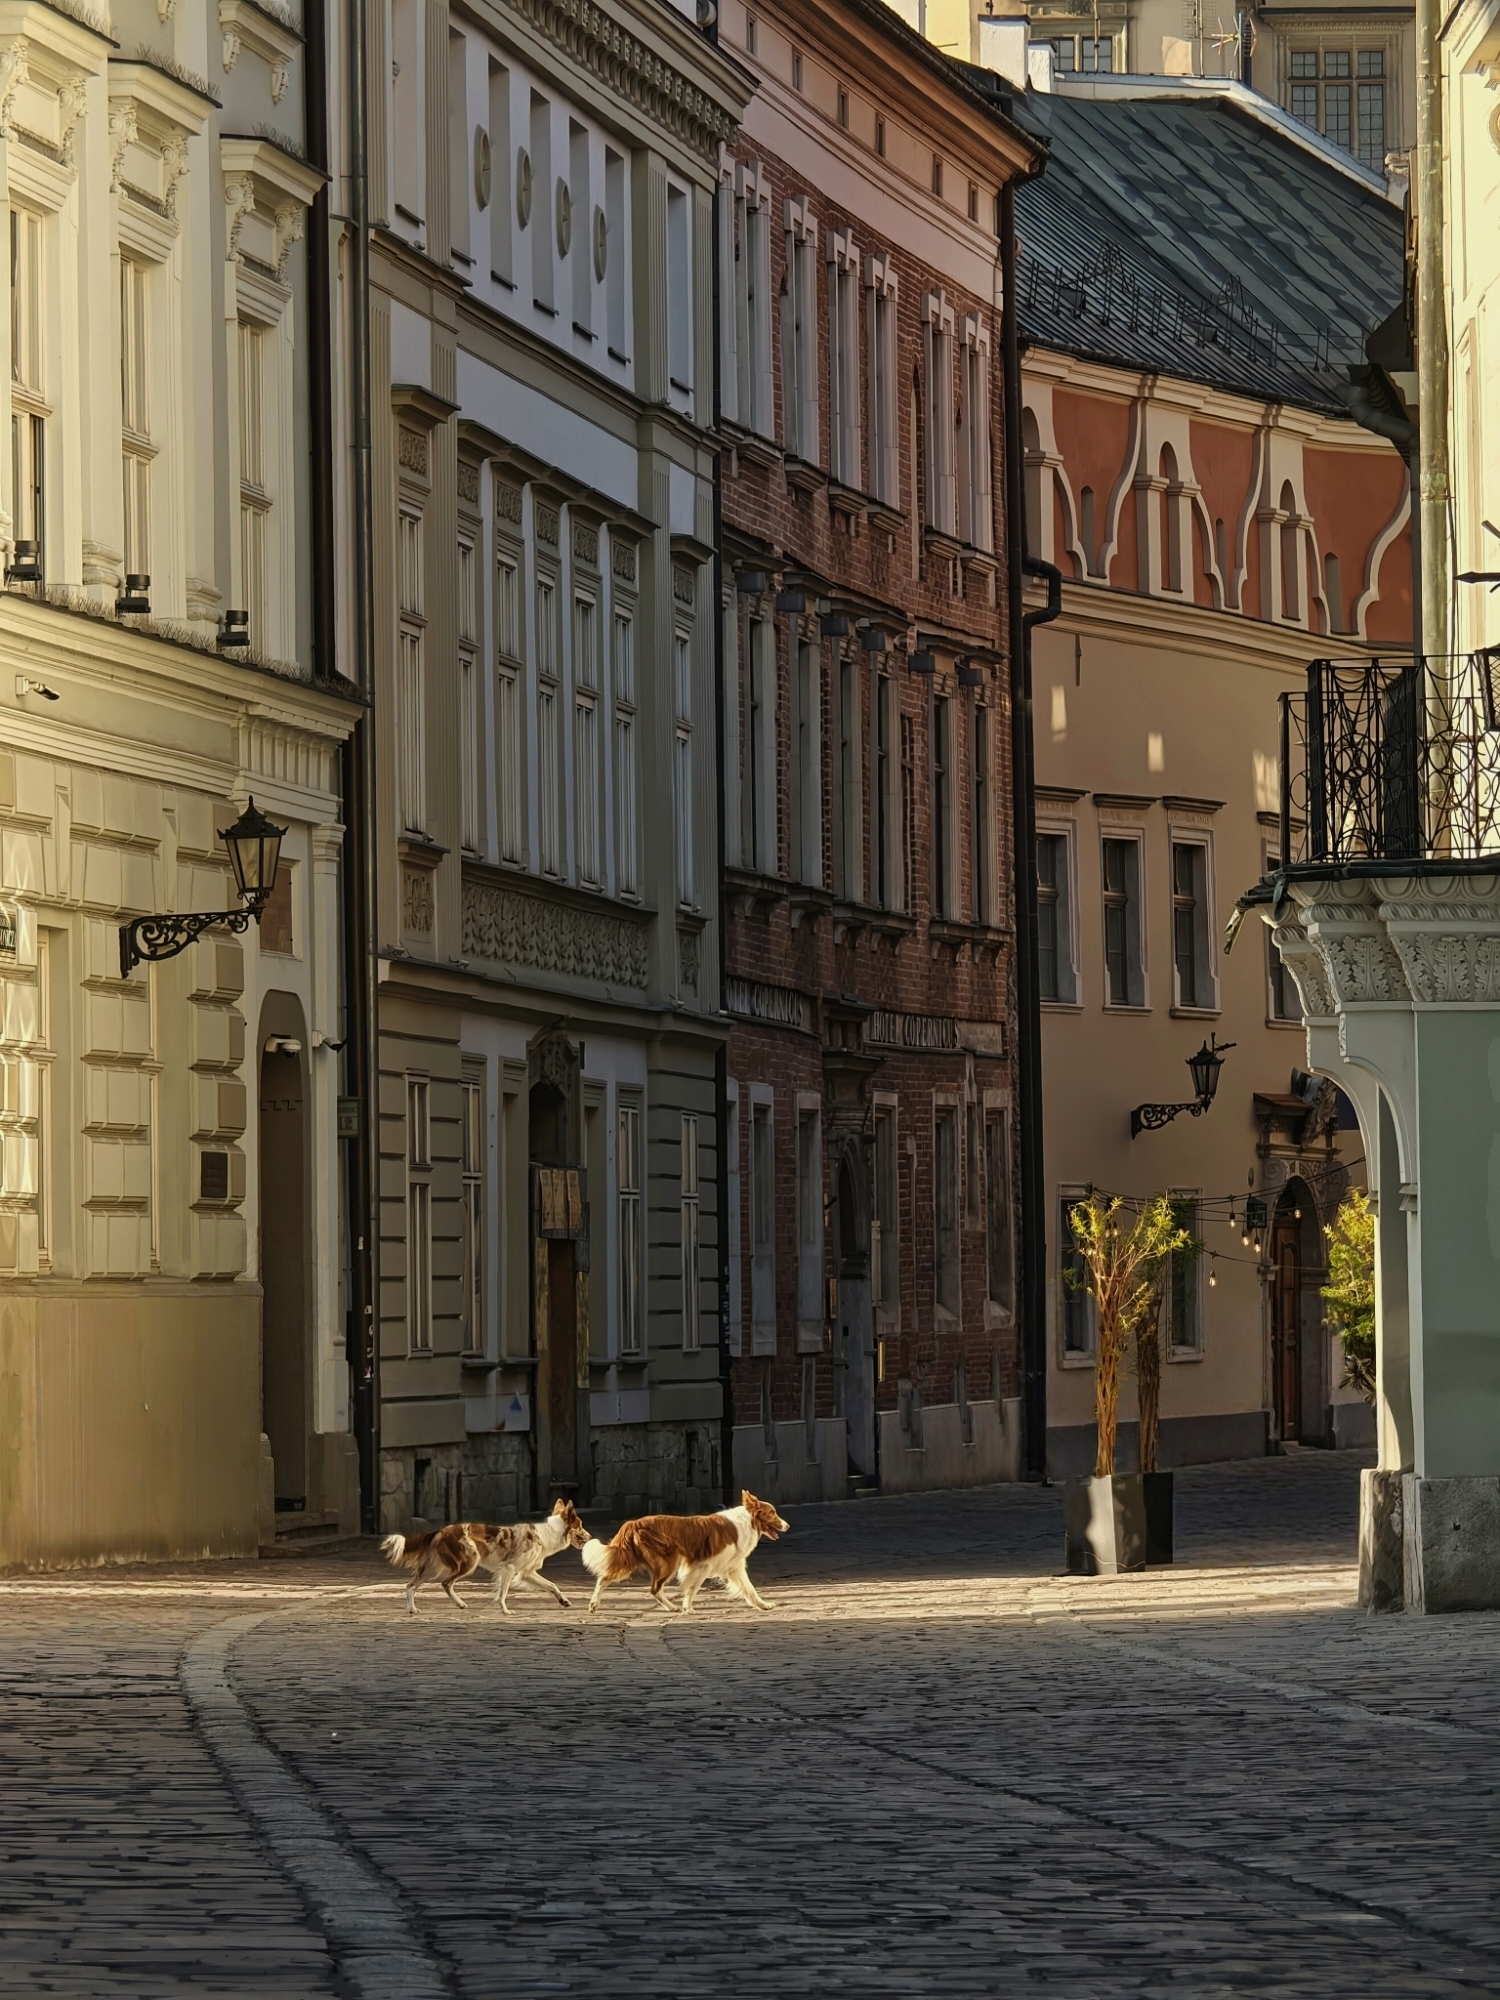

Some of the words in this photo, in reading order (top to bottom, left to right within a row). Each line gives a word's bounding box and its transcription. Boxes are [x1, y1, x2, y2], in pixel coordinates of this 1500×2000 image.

[754, 984, 804, 1027] COPERNICUS
[873, 1011, 902, 1043] HOTEL
[905, 1015, 961, 1049] COPERNICUS
